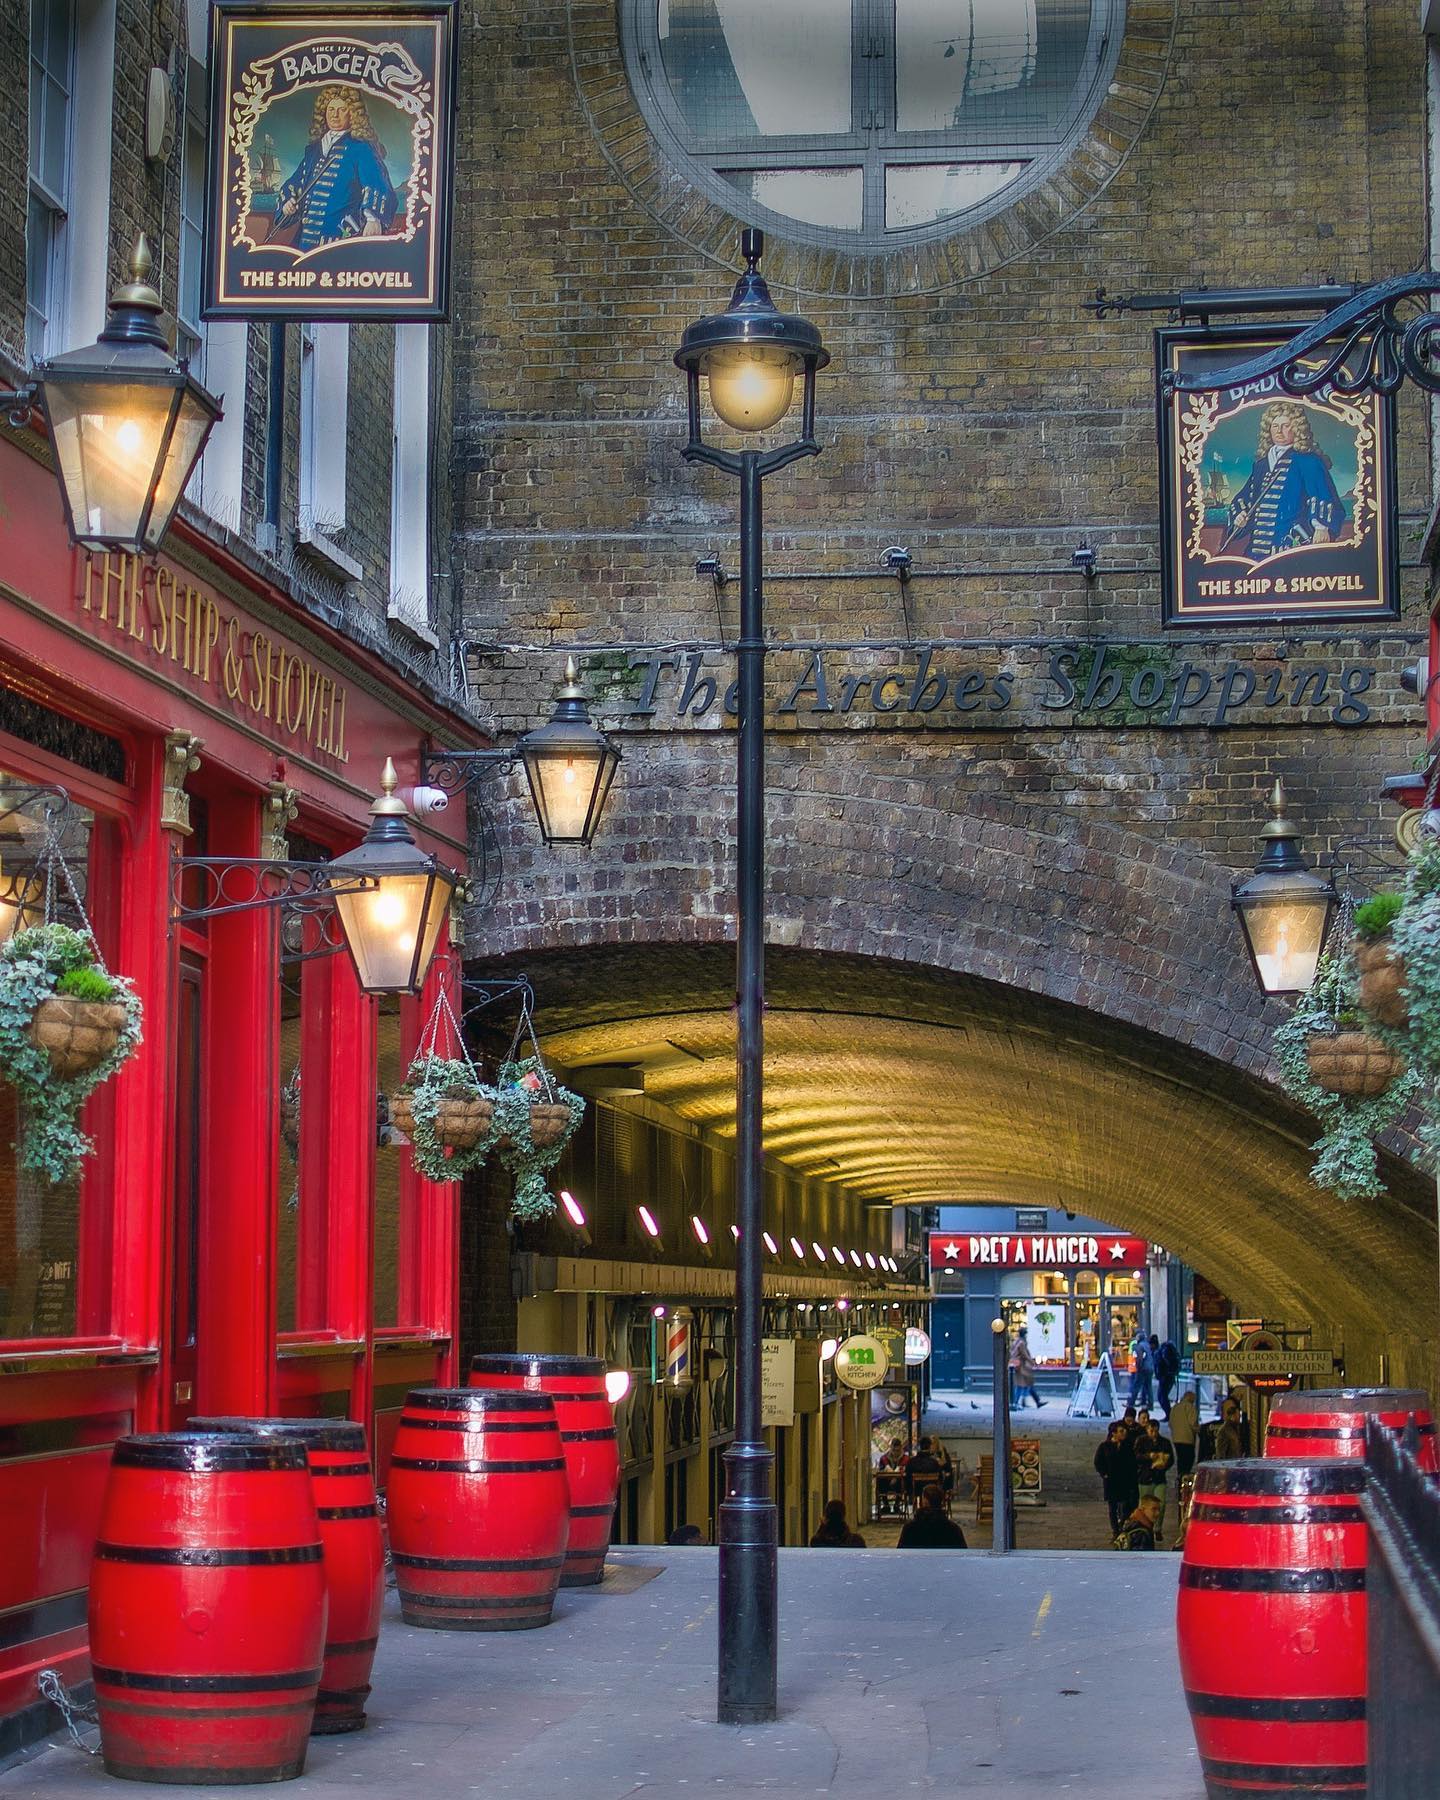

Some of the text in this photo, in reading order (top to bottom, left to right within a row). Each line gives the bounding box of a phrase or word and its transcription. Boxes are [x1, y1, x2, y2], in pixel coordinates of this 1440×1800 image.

[281, 53, 384, 88] BADGER
[240, 271, 412, 287] THE SHIP & SHOVELL
[1198, 575, 1364, 596] THE SHIP & SHOVELL
[152, 566, 220, 683] SHIP
[223, 616, 245, 703] &
[250, 631, 350, 764] SHOVELL
[778, 648, 1015, 714] Arches
[1040, 646, 1376, 726] Shopping
[968, 1236, 1099, 1264] PRET A MANGER
[1197, 1352, 1329, 1361] CHARING CROSS THEATRE
[1201, 1362, 1244, 1371] PLAYERS
[1246, 1362, 1267, 1371] BAR
[1279, 1362, 1325, 1371] KITCHEN
